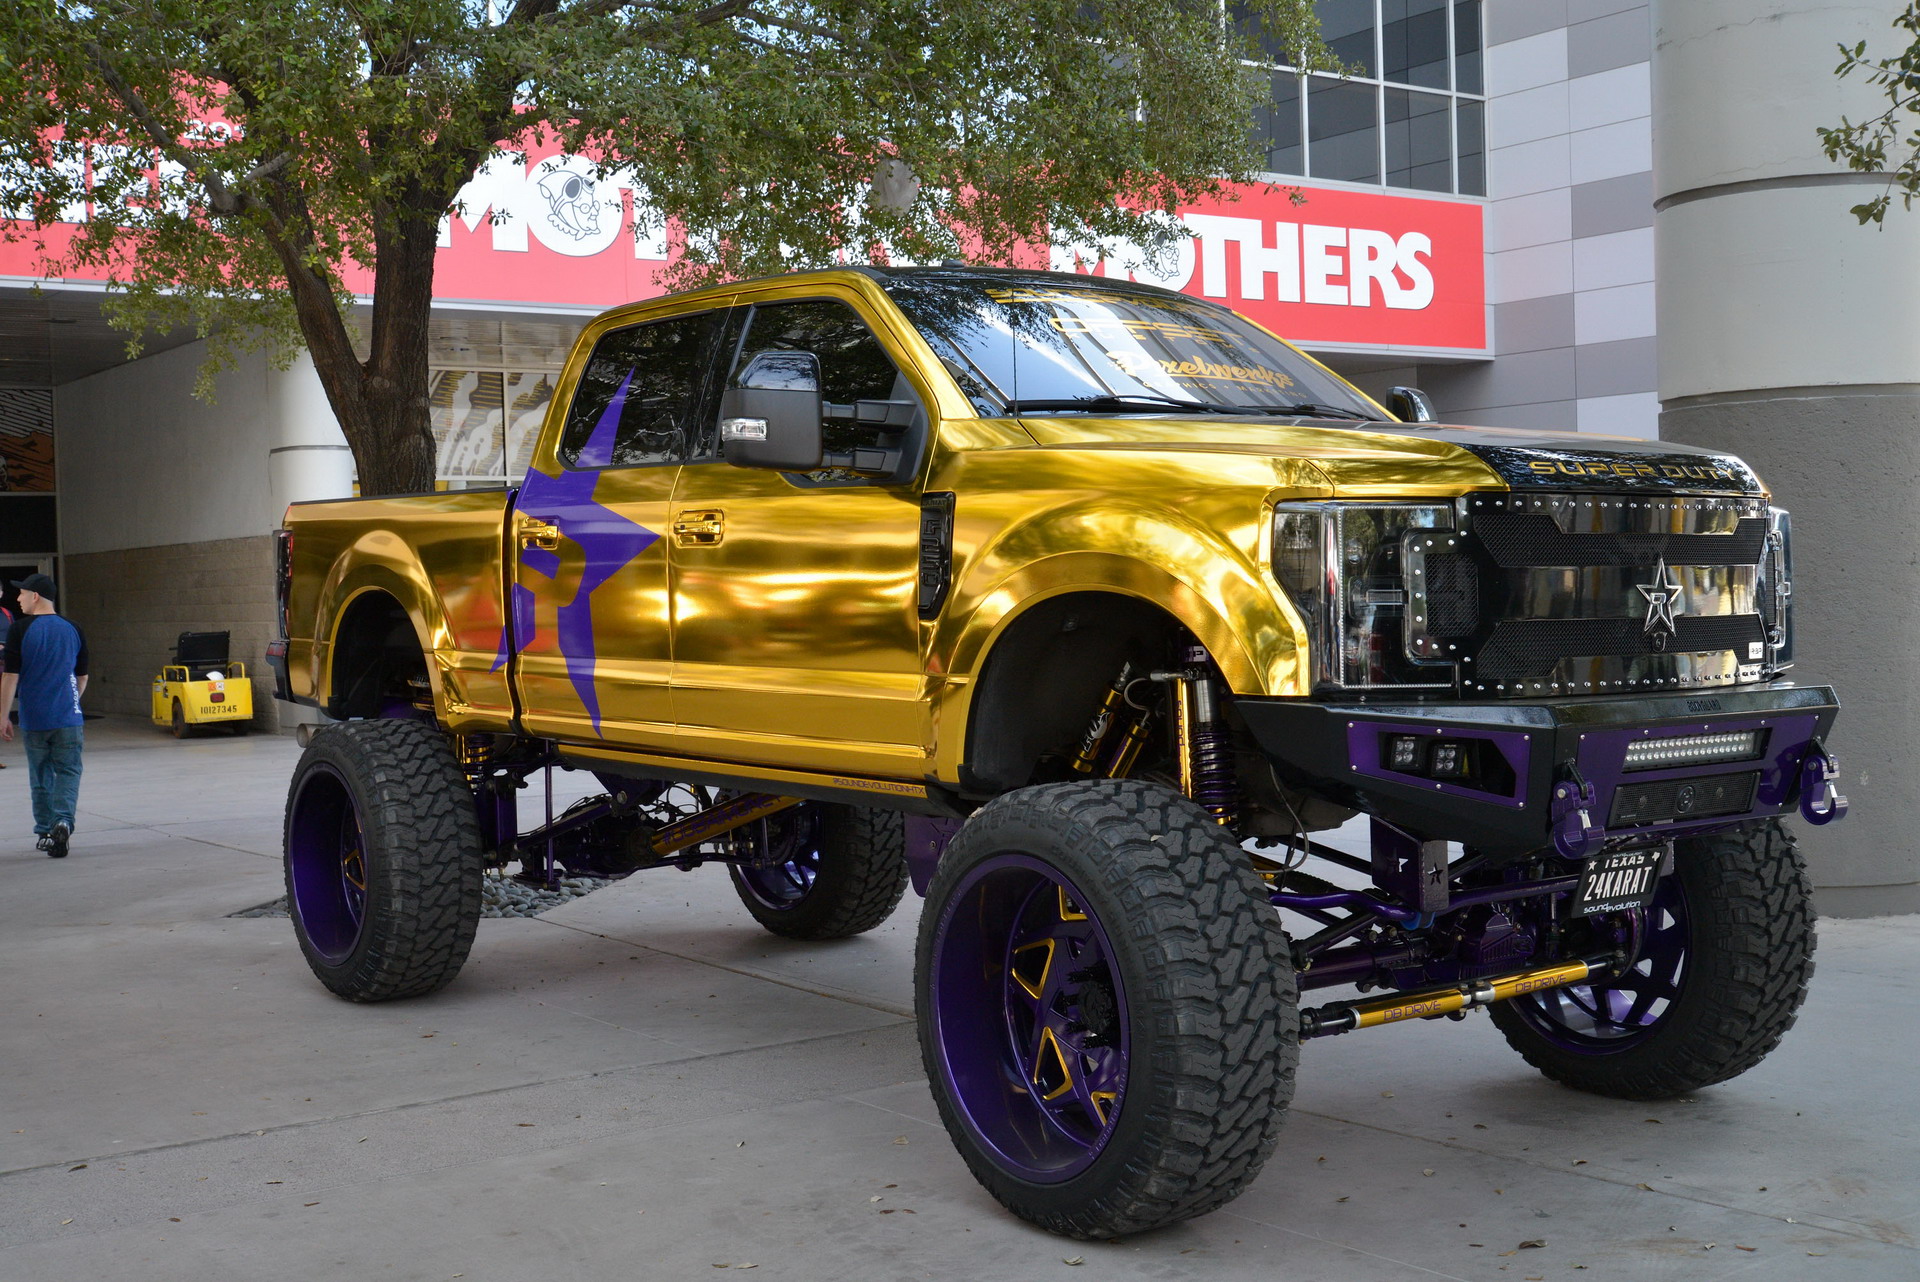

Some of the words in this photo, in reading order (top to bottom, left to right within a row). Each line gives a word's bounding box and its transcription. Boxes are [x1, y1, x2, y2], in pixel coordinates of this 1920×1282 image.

[1048, 204, 1434, 310] MOTHERS
[1105, 349, 1295, 389] Pxelwerks
[1528, 461, 1660, 478] SUPER
[1659, 464, 1737, 481] DUTY
[200, 705, 238, 714] 10127345
[1583, 866, 1653, 901] 24KARAT
[1583, 900, 1641, 914] soundevolution
[1515, 981, 1532, 993] DB
[1533, 974, 1567, 990] DRIVE
[1383, 1008, 1403, 1021] DB
[1404, 1001, 1442, 1018] DRIVE
